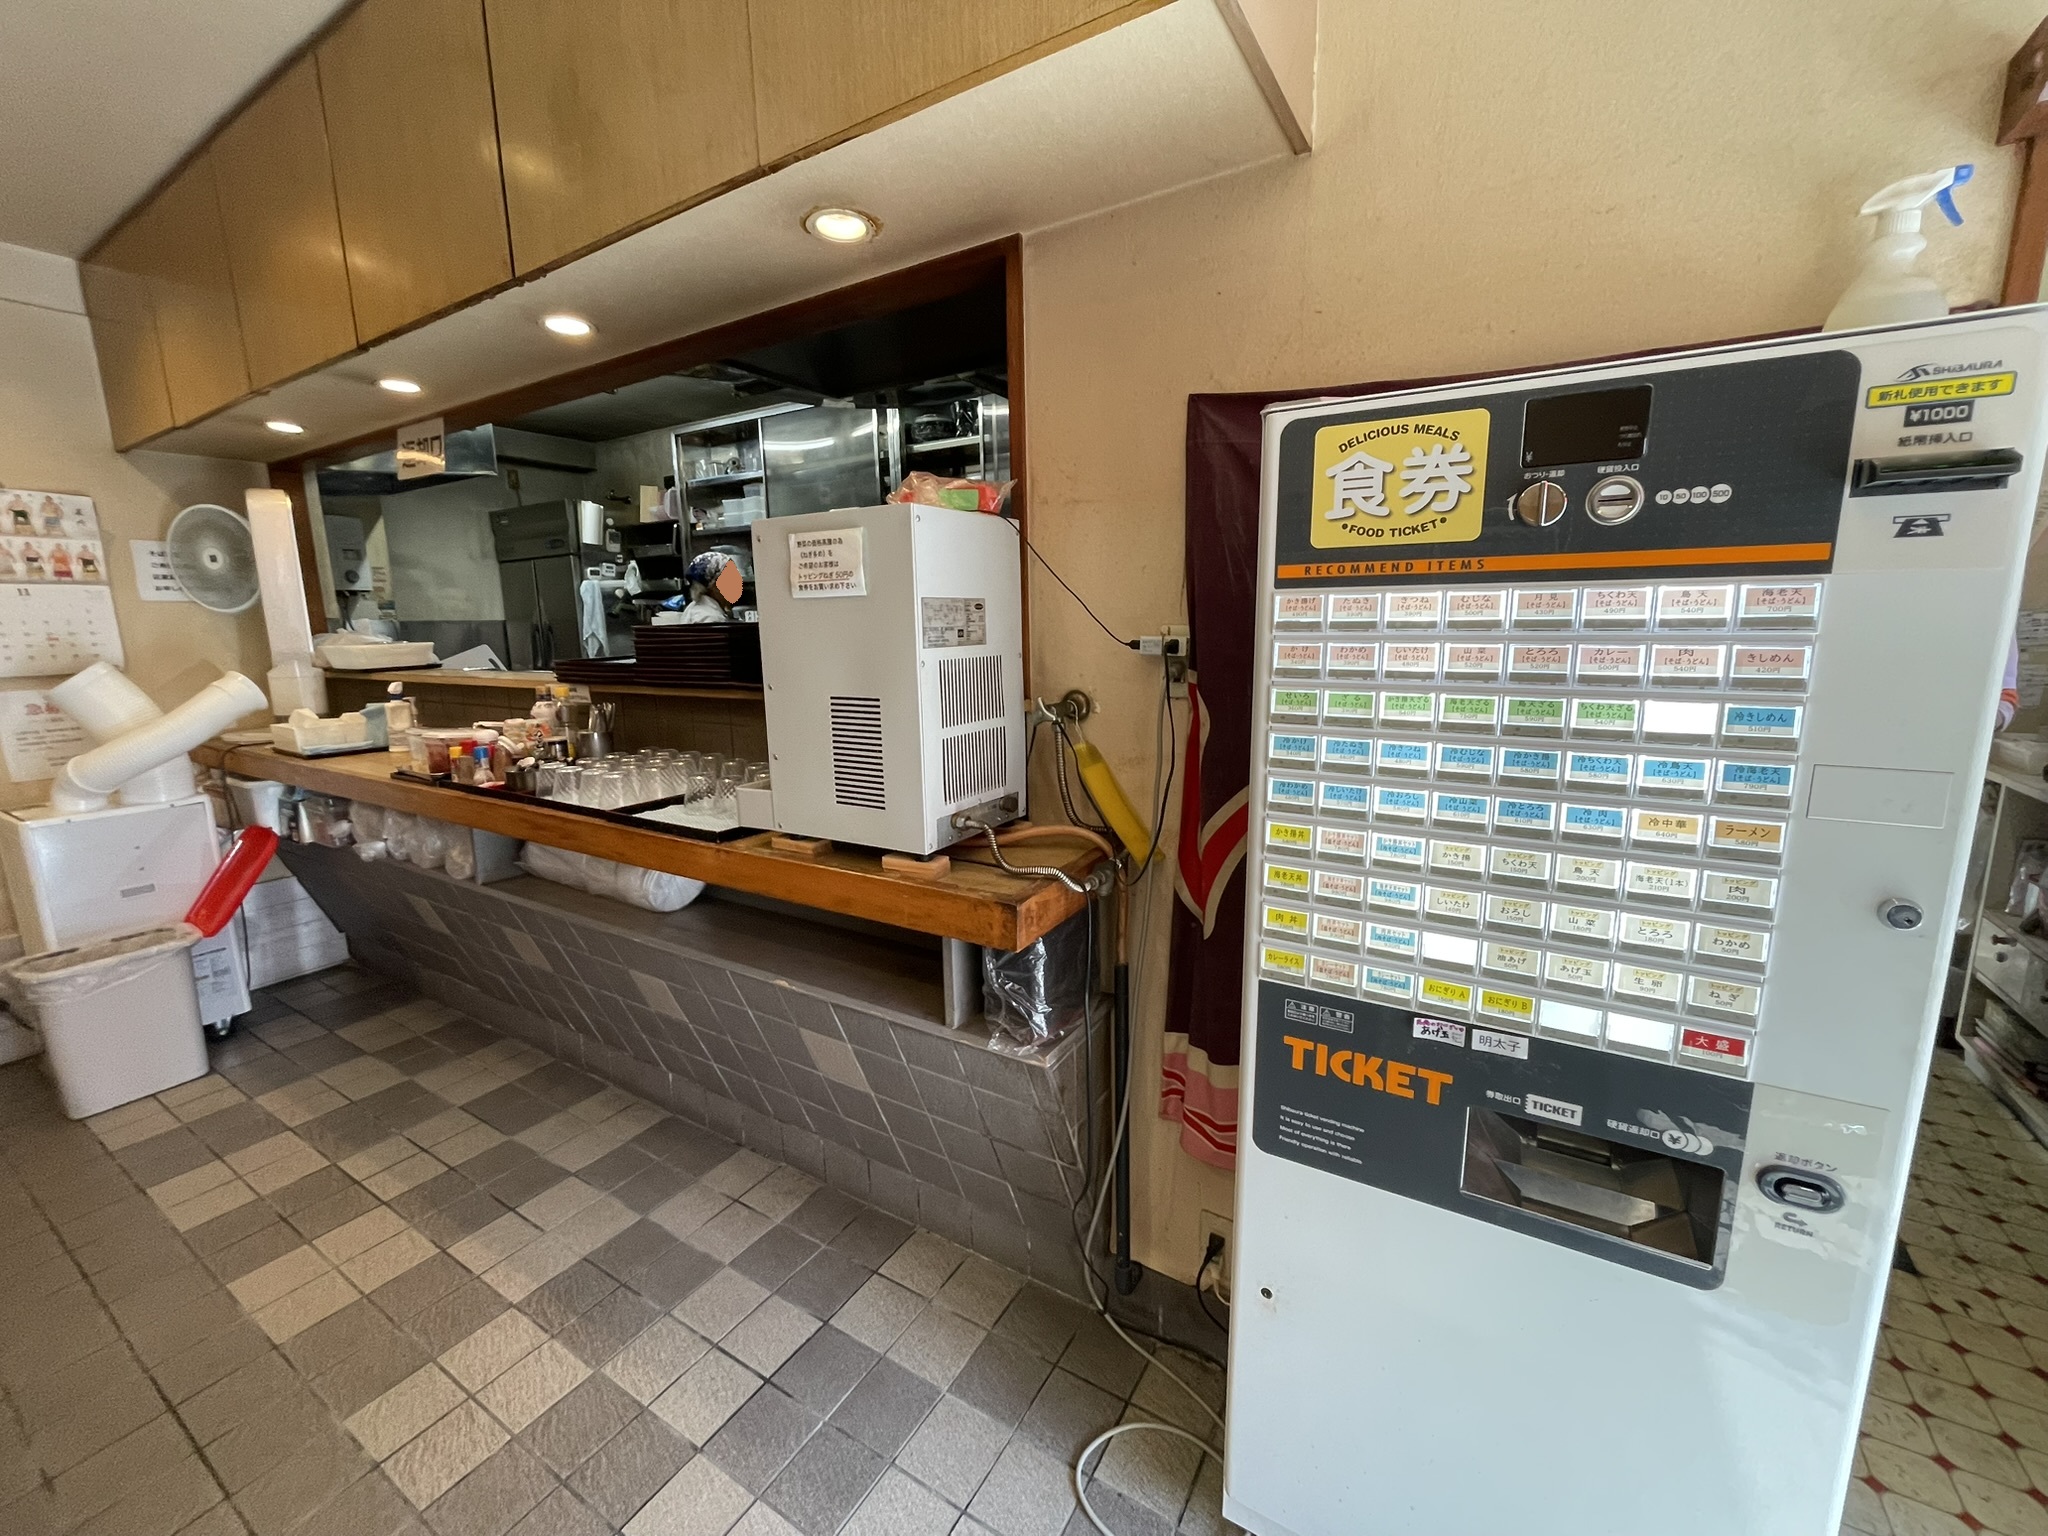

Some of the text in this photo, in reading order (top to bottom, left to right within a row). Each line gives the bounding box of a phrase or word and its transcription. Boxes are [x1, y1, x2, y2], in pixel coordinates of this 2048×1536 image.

[1877, 379, 2003, 402] 新札使用できます
[1909, 404, 1969, 422] ¥1000
[1338, 423, 1461, 454] DELICIOUS MEALS
[1324, 443, 1472, 520] 食券
[1348, 520, 1439, 538] FOOD TICKET
[1305, 559, 1485, 576] RECOMMEND ITEMS
[1598, 591, 1636, 599] ちくわ天
[1680, 590, 1708, 598] 鳥天
[1762, 588, 1802, 596] 海老天
[1594, 648, 1628, 656] カレー
[1747, 654, 1794, 662] きしめん
[1734, 712, 1787, 722] 冷きしめん
[1658, 761, 1693, 770] 冷鳥天
[1735, 766, 1780, 775] 冷海老天
[1649, 818, 1687, 828] 冷中華
[1725, 825, 1771, 838] ラーメン
[1636, 875, 1689, 887] 海老天(1本)
[1729, 886, 1746, 894] 肉
[1638, 927, 1673, 938] とろろ
[1713, 938, 1750, 949] わかめ
[1634, 977, 1662, 987] 生卵
[1428, 985, 1455, 996] おにぎり
[1709, 991, 1739, 1001] ねぎ
[1488, 996, 1517, 1008] おにぎり
[1479, 1035, 1521, 1052] 明太子
[1695, 1036, 1730, 1052] 大盛
[1283, 1035, 1454, 1105] TICKET
[1532, 1099, 1578, 1119] TICKET
[1775, 1222, 1813, 1237] RETURN
